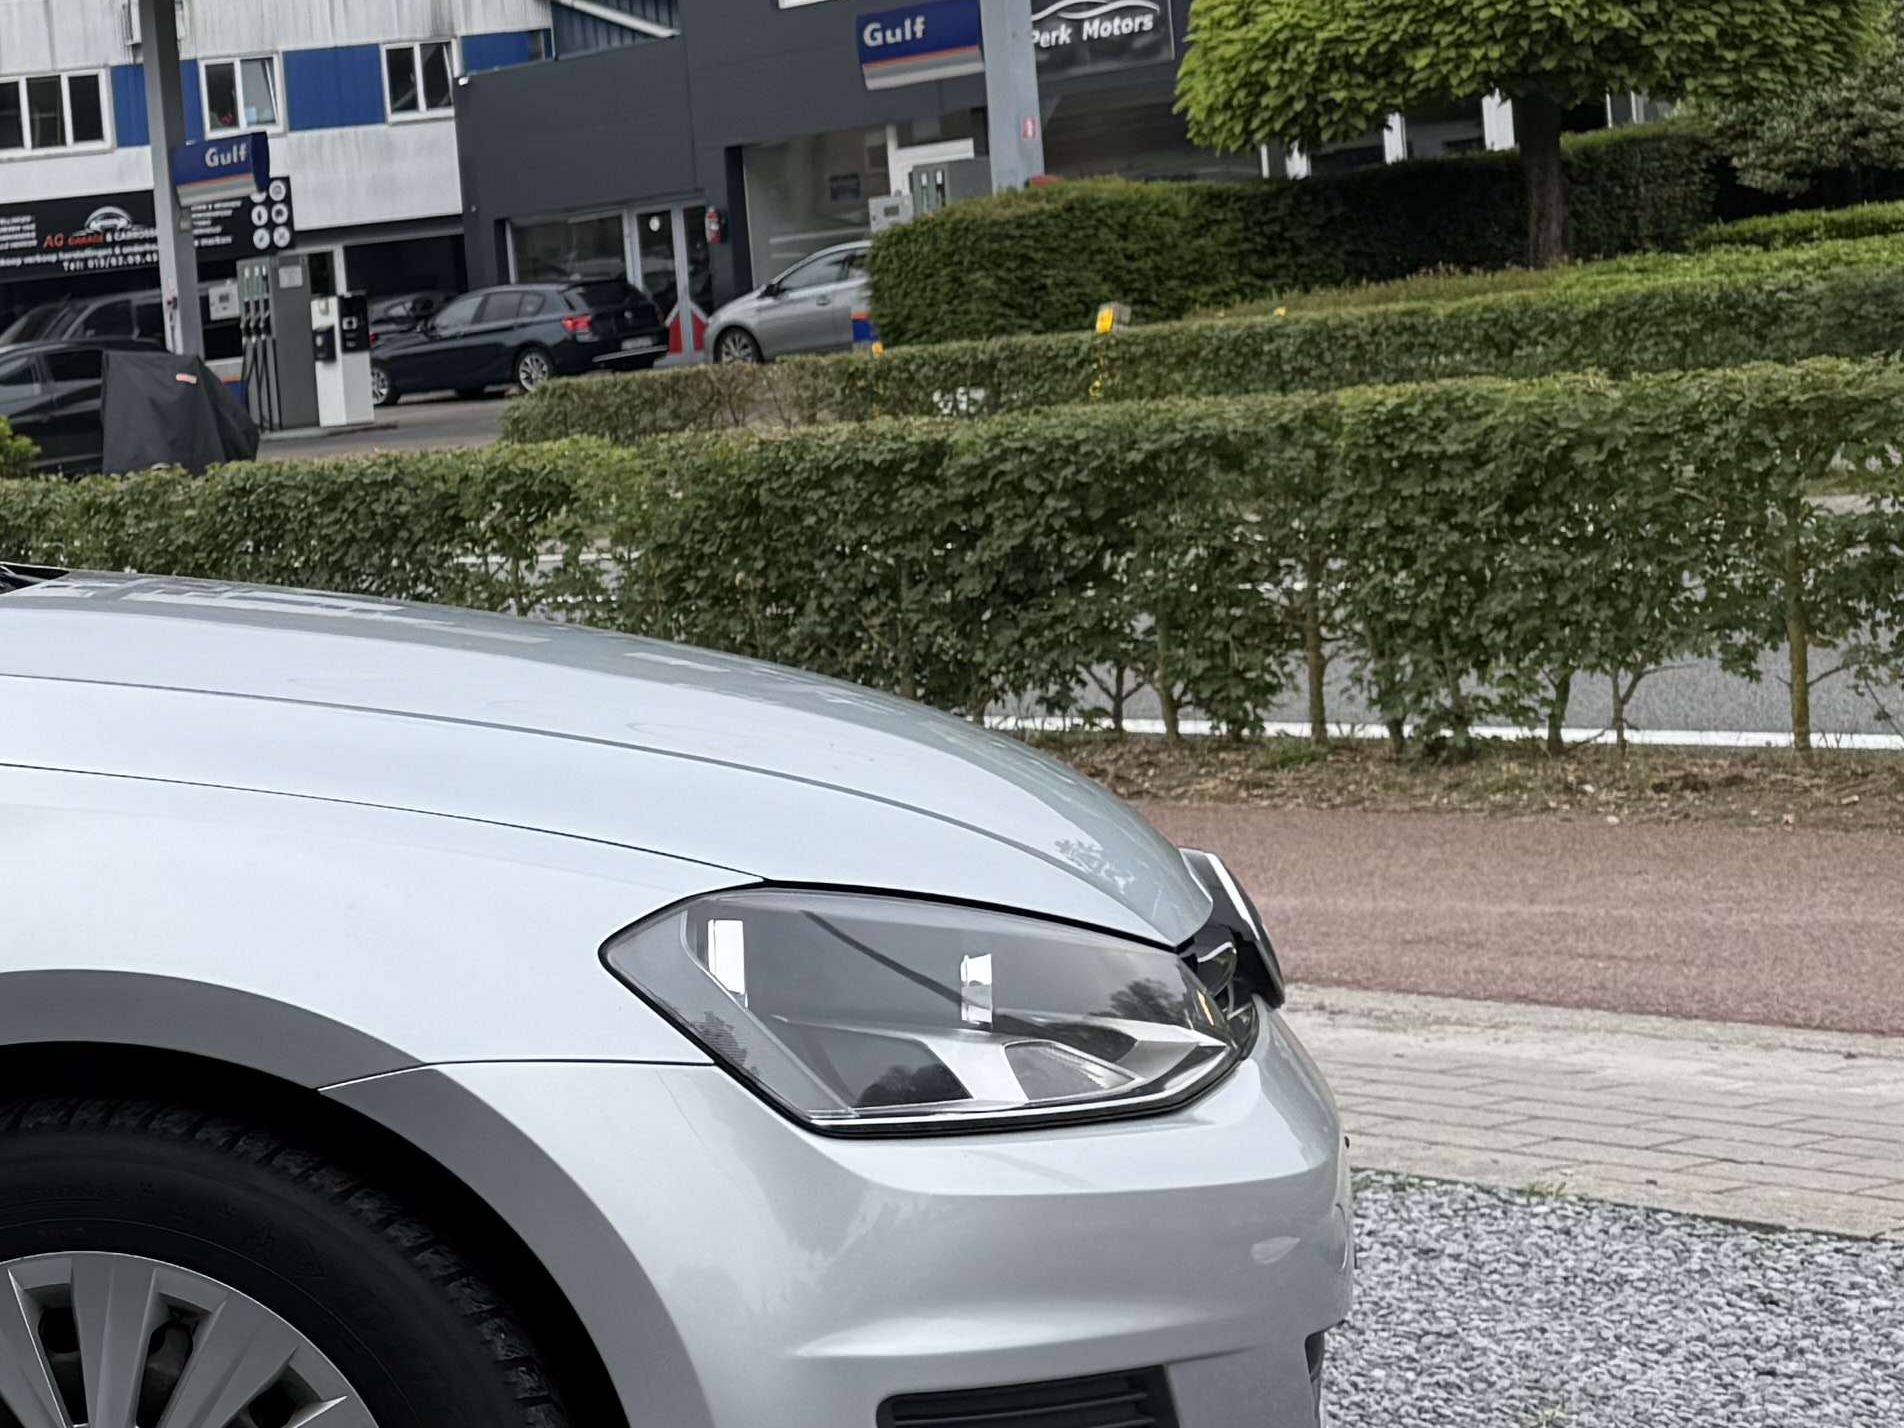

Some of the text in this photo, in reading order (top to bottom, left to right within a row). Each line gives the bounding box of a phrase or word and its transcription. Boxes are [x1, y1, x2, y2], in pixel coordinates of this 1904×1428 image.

[863, 16, 927, 47] Gulf
[1082, 14, 1153, 41] Motors
[205, 143, 248, 167] Gulf
